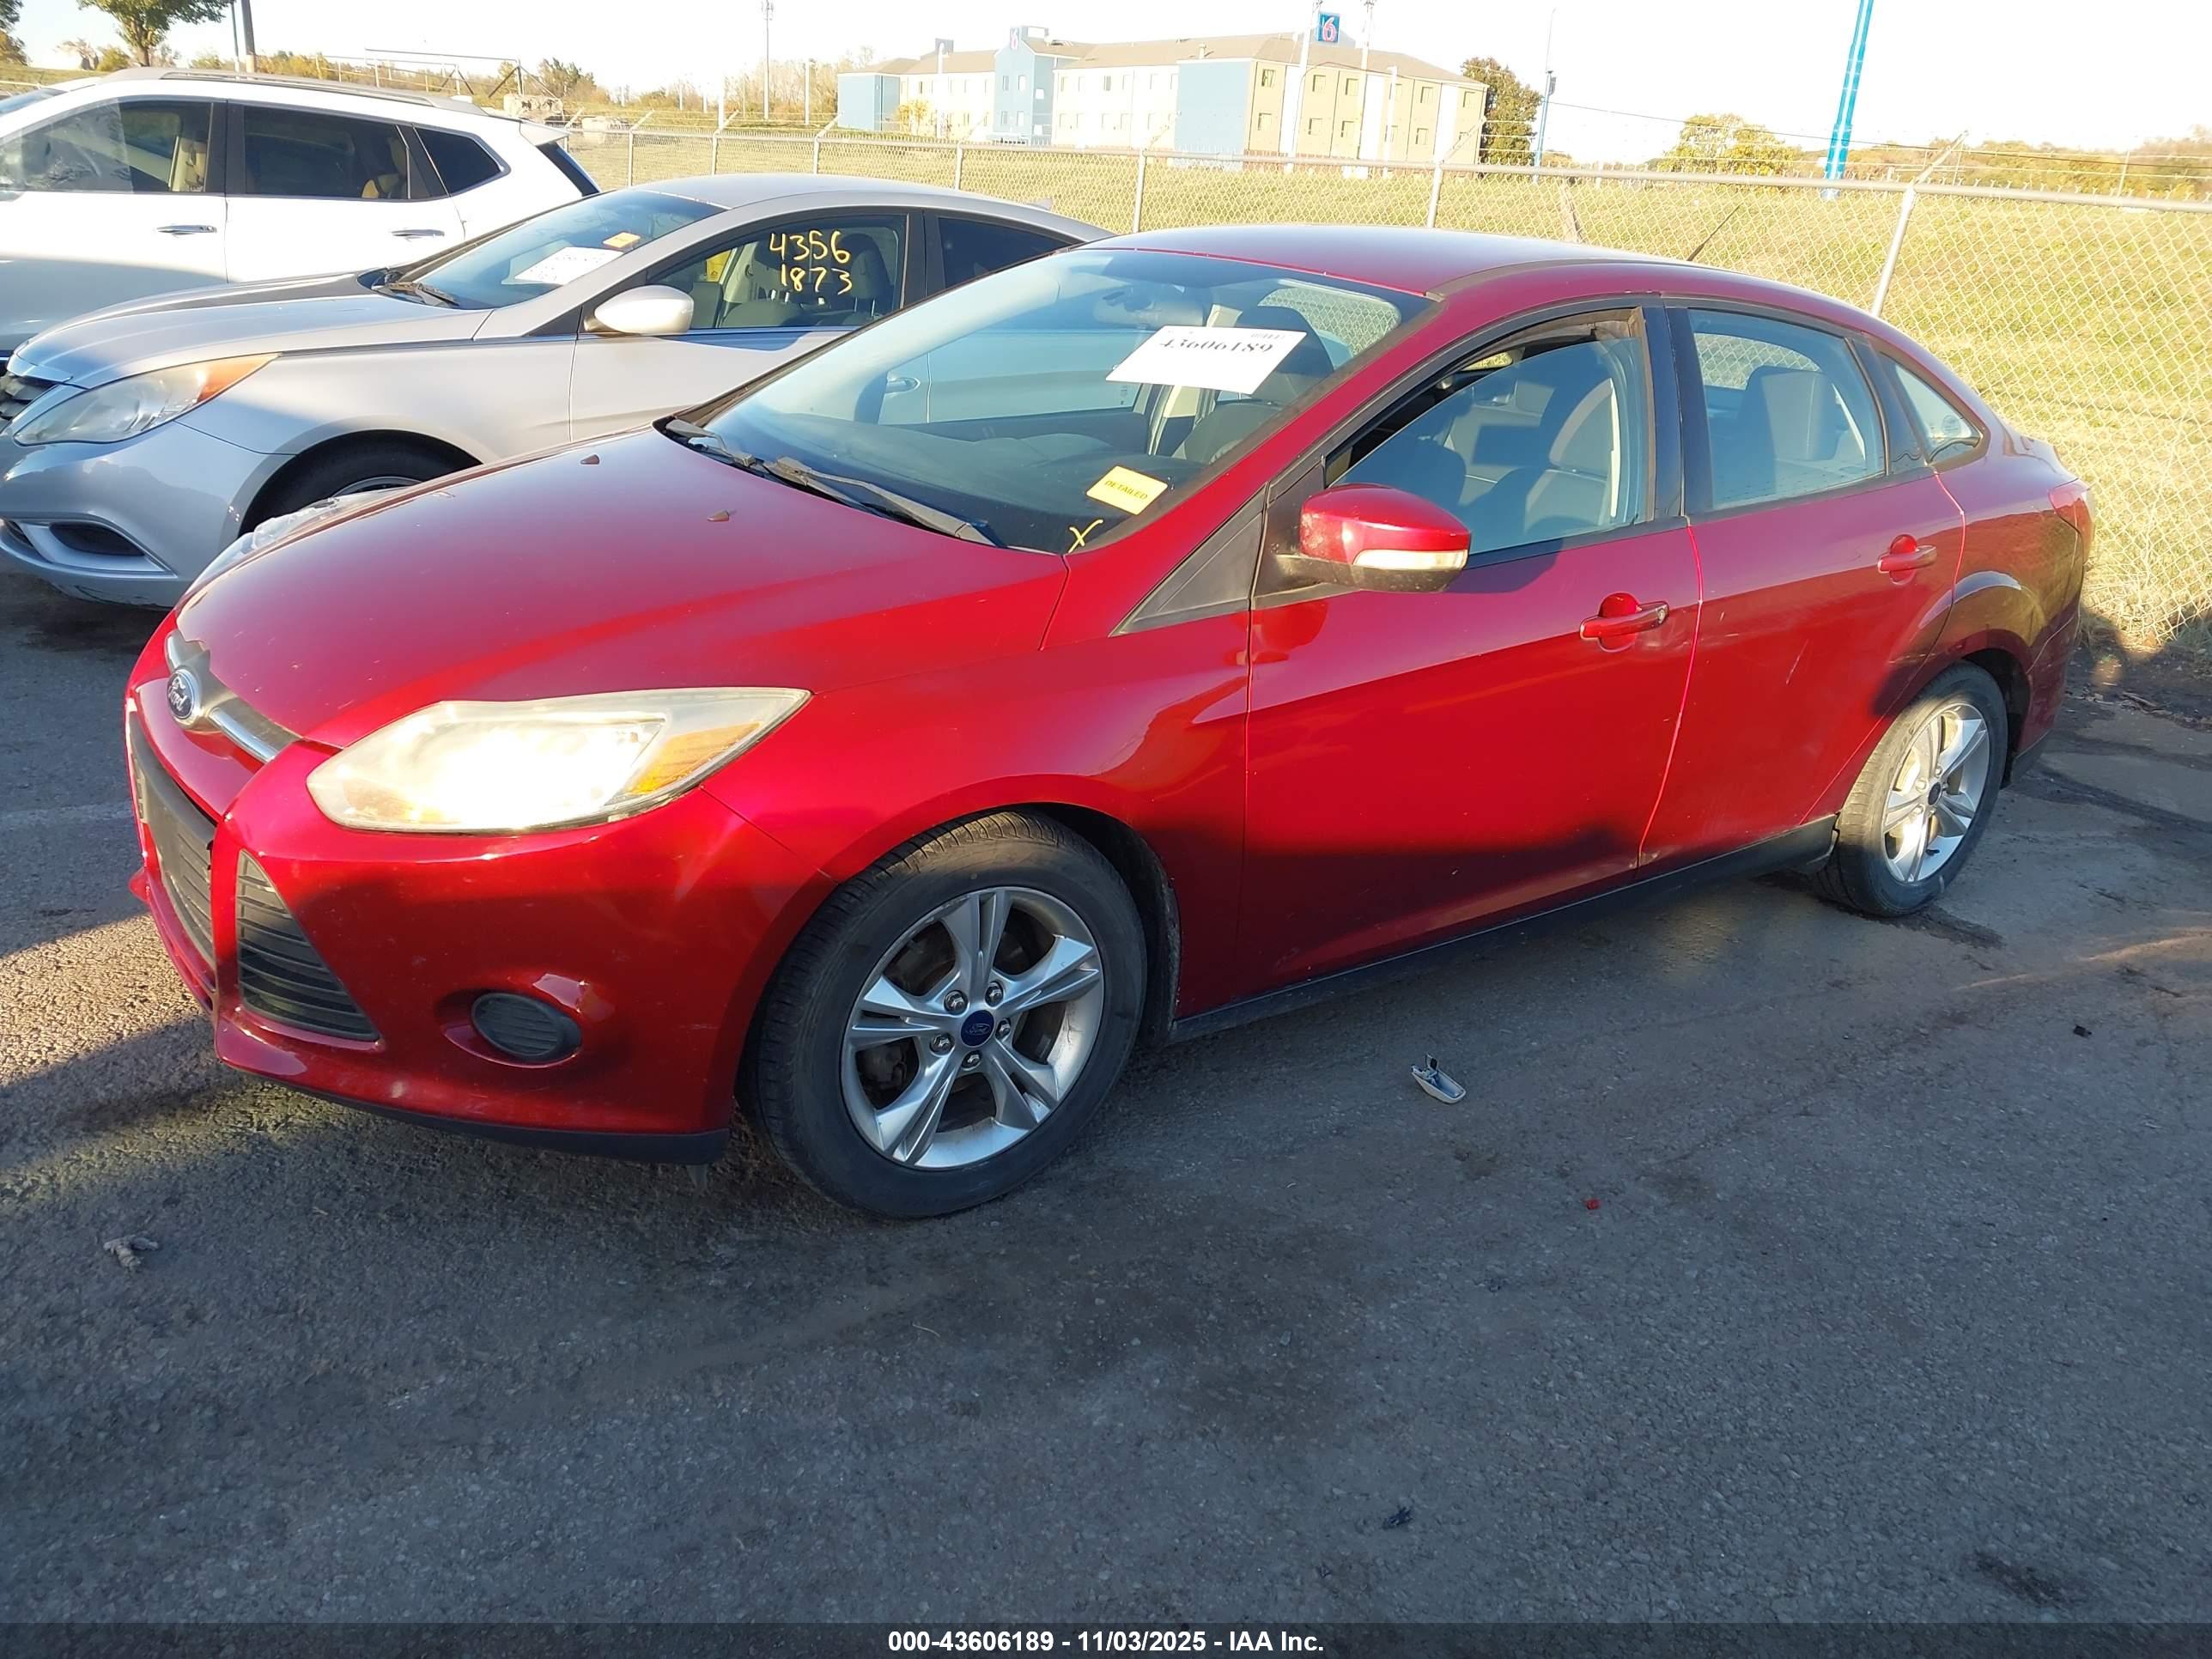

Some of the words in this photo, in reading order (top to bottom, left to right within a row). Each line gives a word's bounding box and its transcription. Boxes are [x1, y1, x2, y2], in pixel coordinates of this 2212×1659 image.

[1322, 16, 1336, 42] 6
[769, 230, 851, 264] 4356
[781, 264, 853, 295] 1873
[168, 675, 188, 712] Ford
